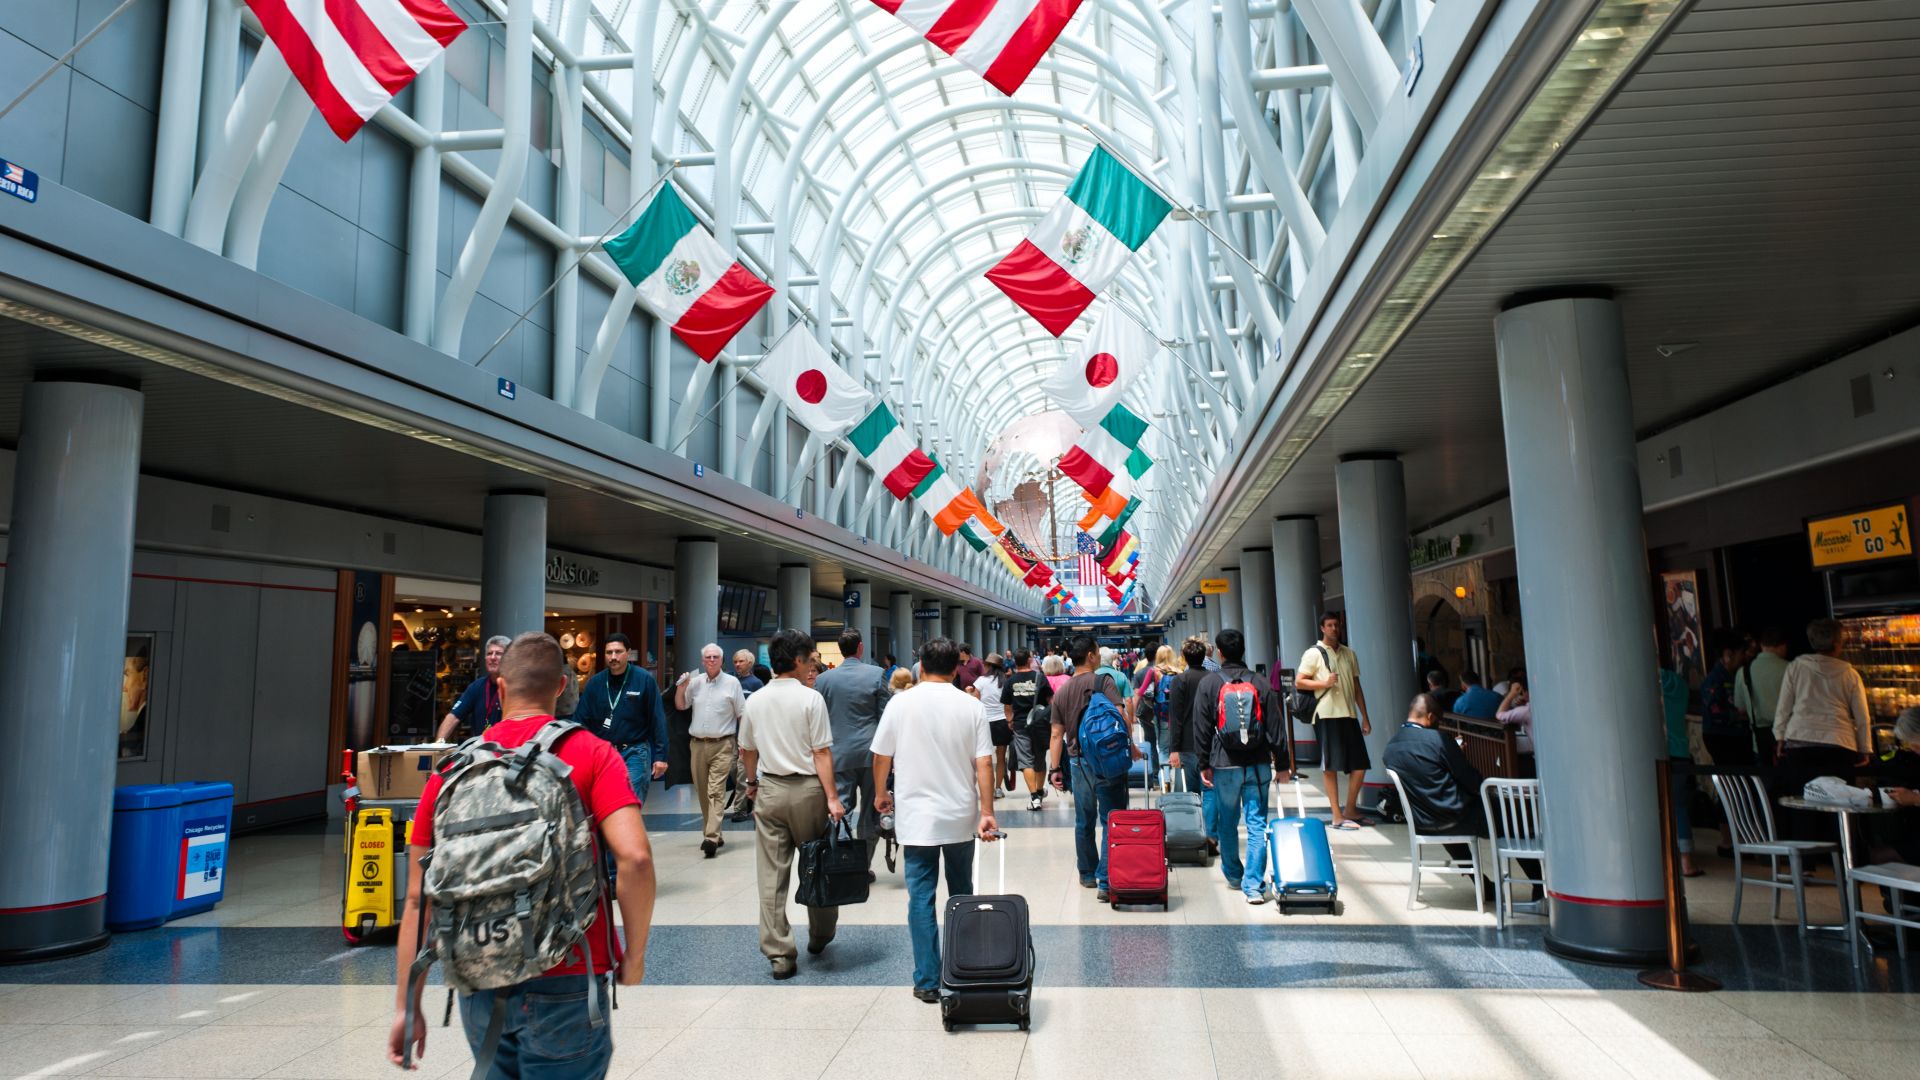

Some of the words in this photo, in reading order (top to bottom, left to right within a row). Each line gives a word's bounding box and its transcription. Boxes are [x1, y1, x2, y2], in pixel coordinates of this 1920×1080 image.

[1852, 518, 1871, 535] TO
[1815, 530, 1852, 547] Macaroni
[1864, 536, 1884, 553] GO
[185, 827, 204, 835] Chicago
[360, 841, 385, 849] CLOSED
[474, 919, 510, 947] US
